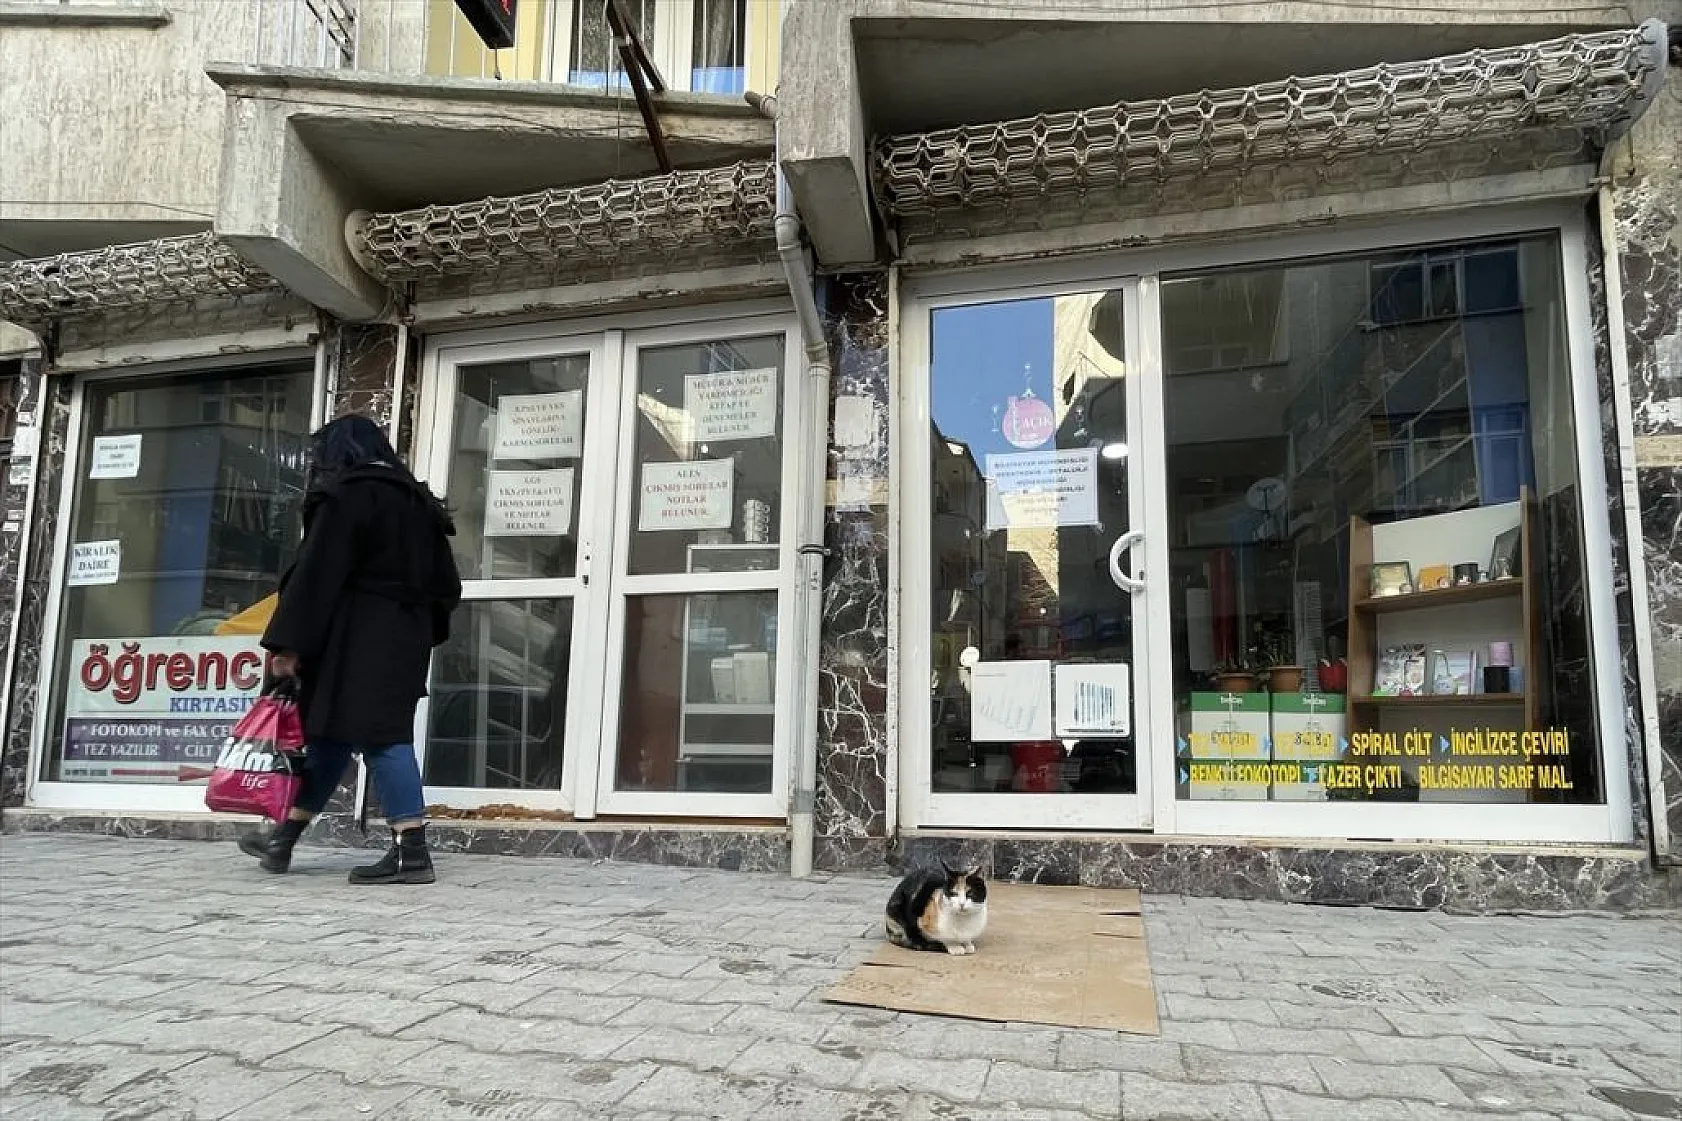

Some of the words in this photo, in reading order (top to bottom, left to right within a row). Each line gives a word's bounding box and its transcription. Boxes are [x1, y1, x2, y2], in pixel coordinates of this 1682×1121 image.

[91, 722, 161, 738] FOTOKOPİ
[164, 727, 180, 737] ve
[184, 724, 206, 738] FAX
[83, 744, 108, 756] TEZ
[1352, 728, 1400, 756] SPİRAL
[1404, 726, 1432, 756] CİLT
[1451, 726, 1518, 756] İNGİLİZCE
[1522, 726, 1570, 762] ÇEVİRİ
[1365, 765, 1402, 795] ÇIKTI
[1418, 758, 1495, 789] BİLGİSAYAR
[1498, 765, 1533, 789] SARF
